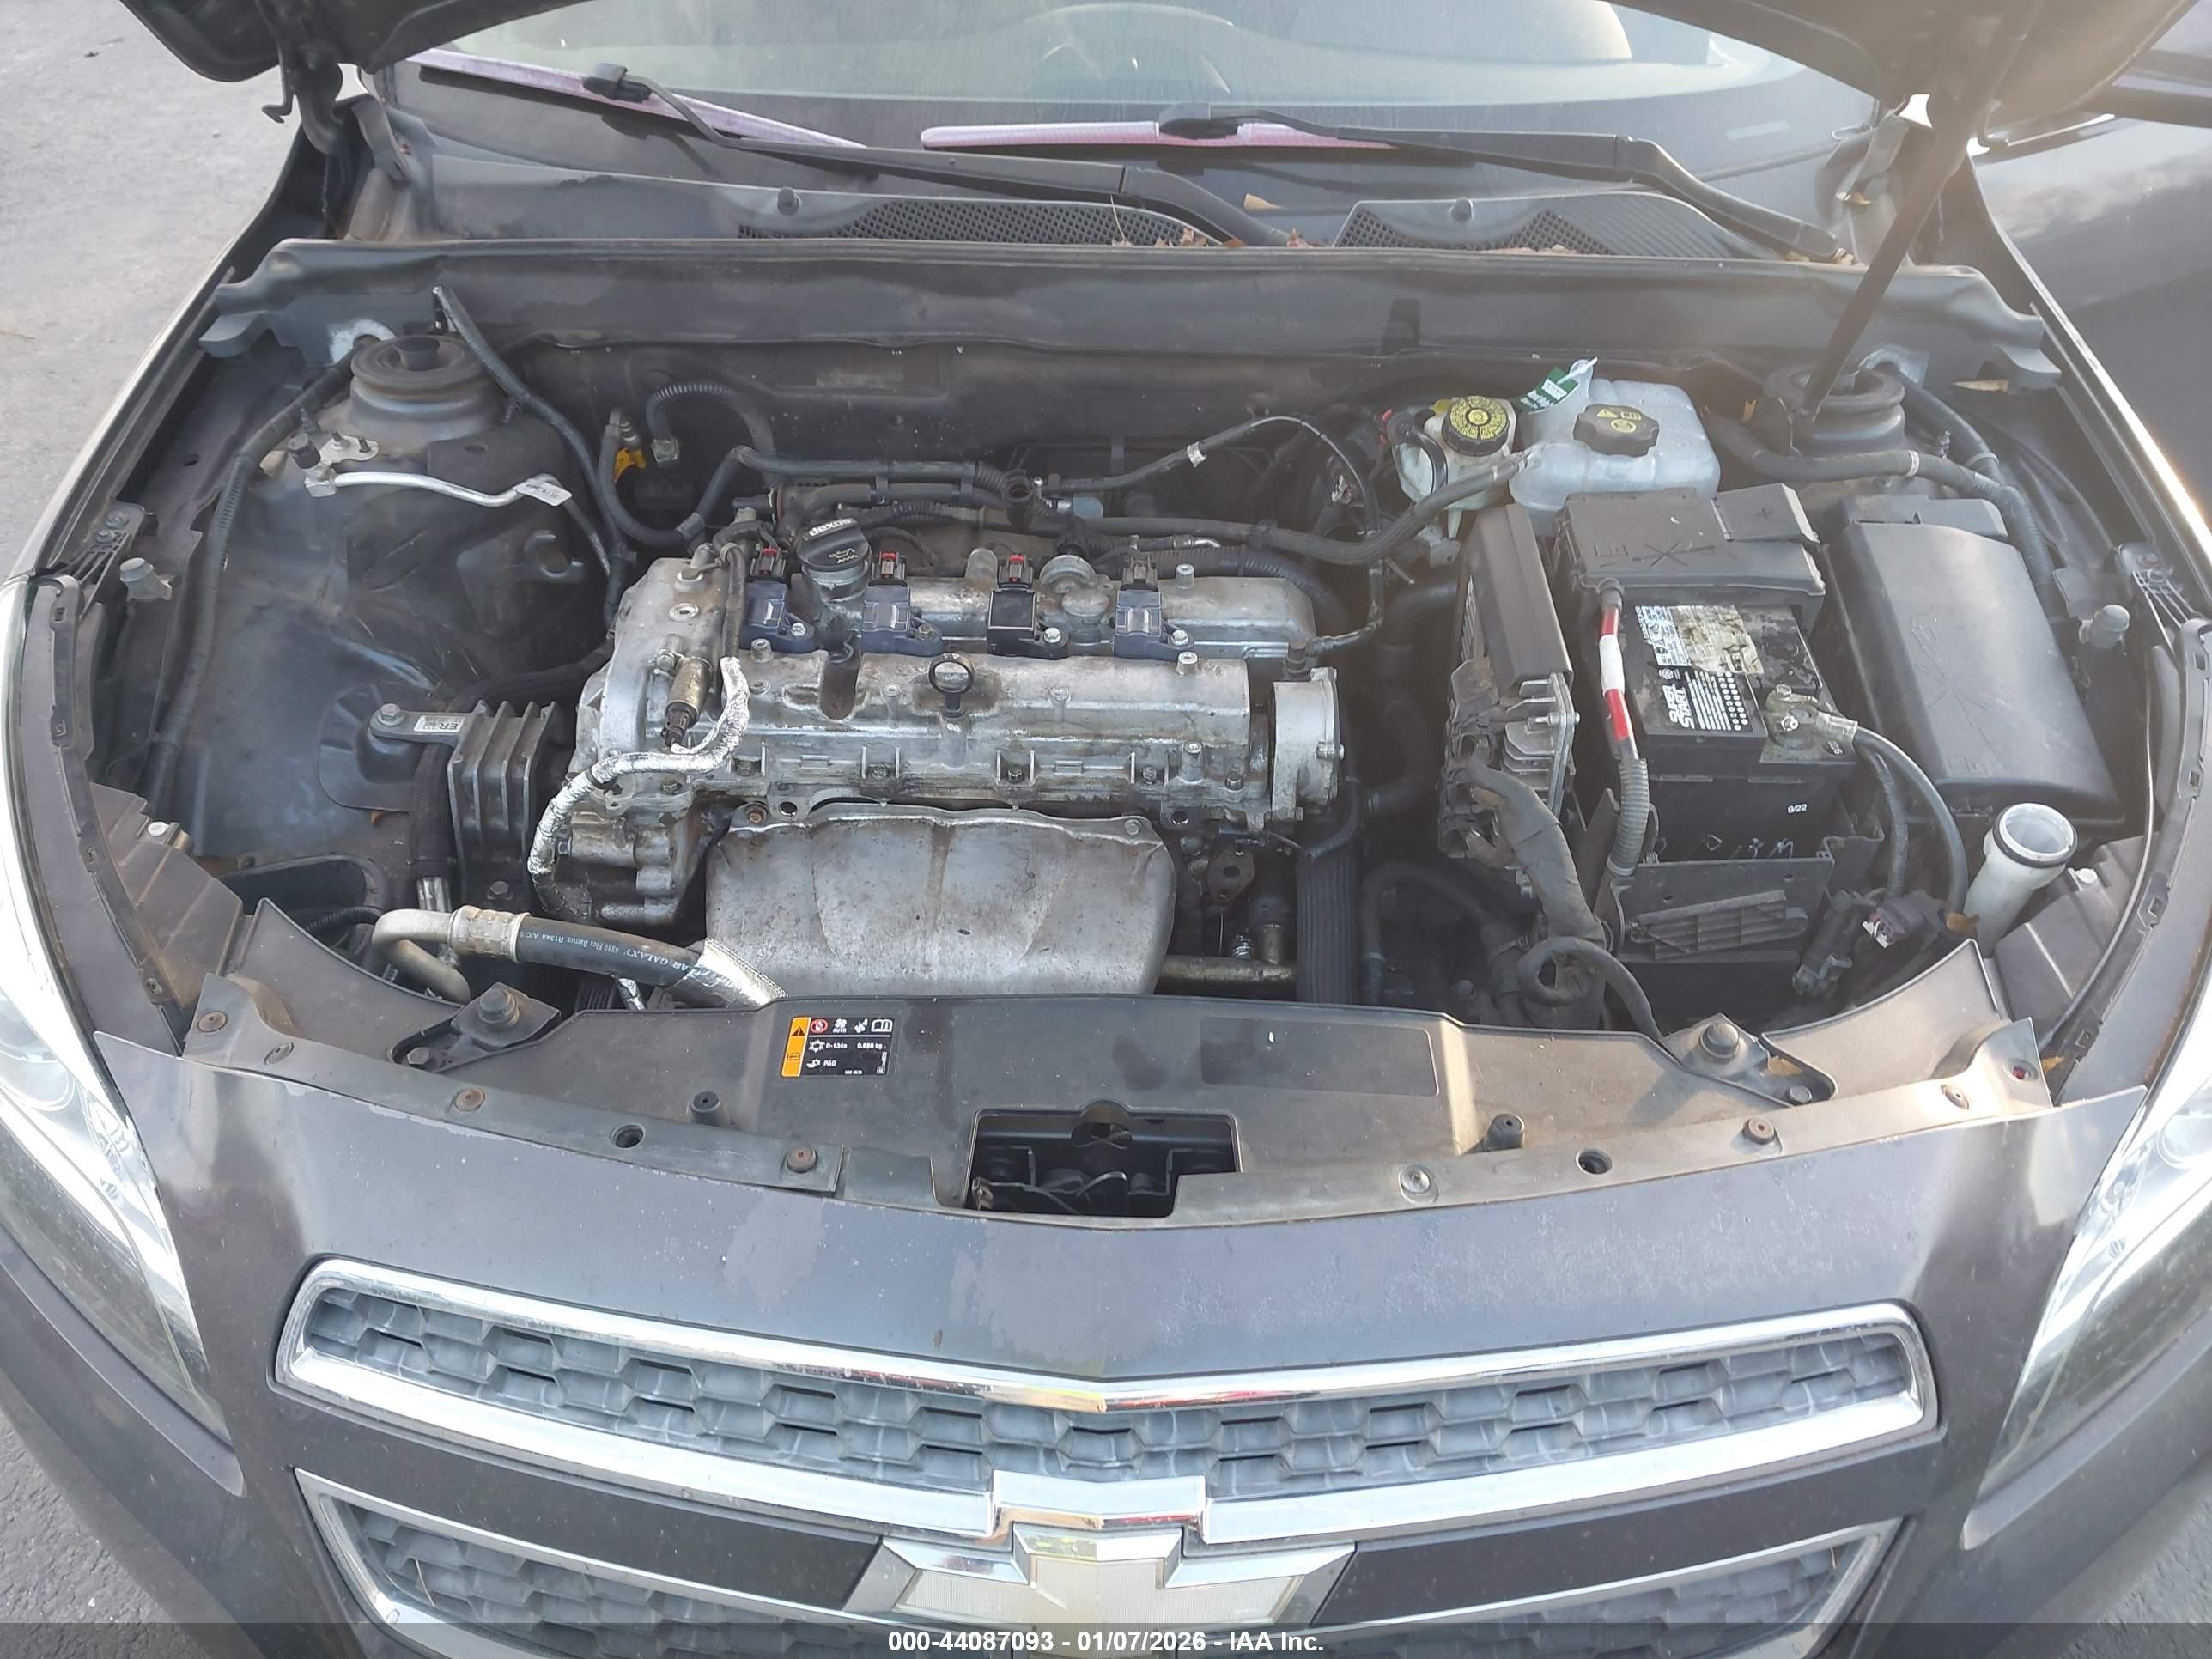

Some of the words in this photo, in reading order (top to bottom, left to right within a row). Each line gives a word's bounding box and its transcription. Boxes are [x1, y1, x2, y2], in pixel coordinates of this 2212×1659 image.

[809, 520, 851, 536] dexos
[1662, 684, 1679, 723] SUPER
[1673, 684, 1696, 729] START
[623, 948, 668, 965] GALAXY
